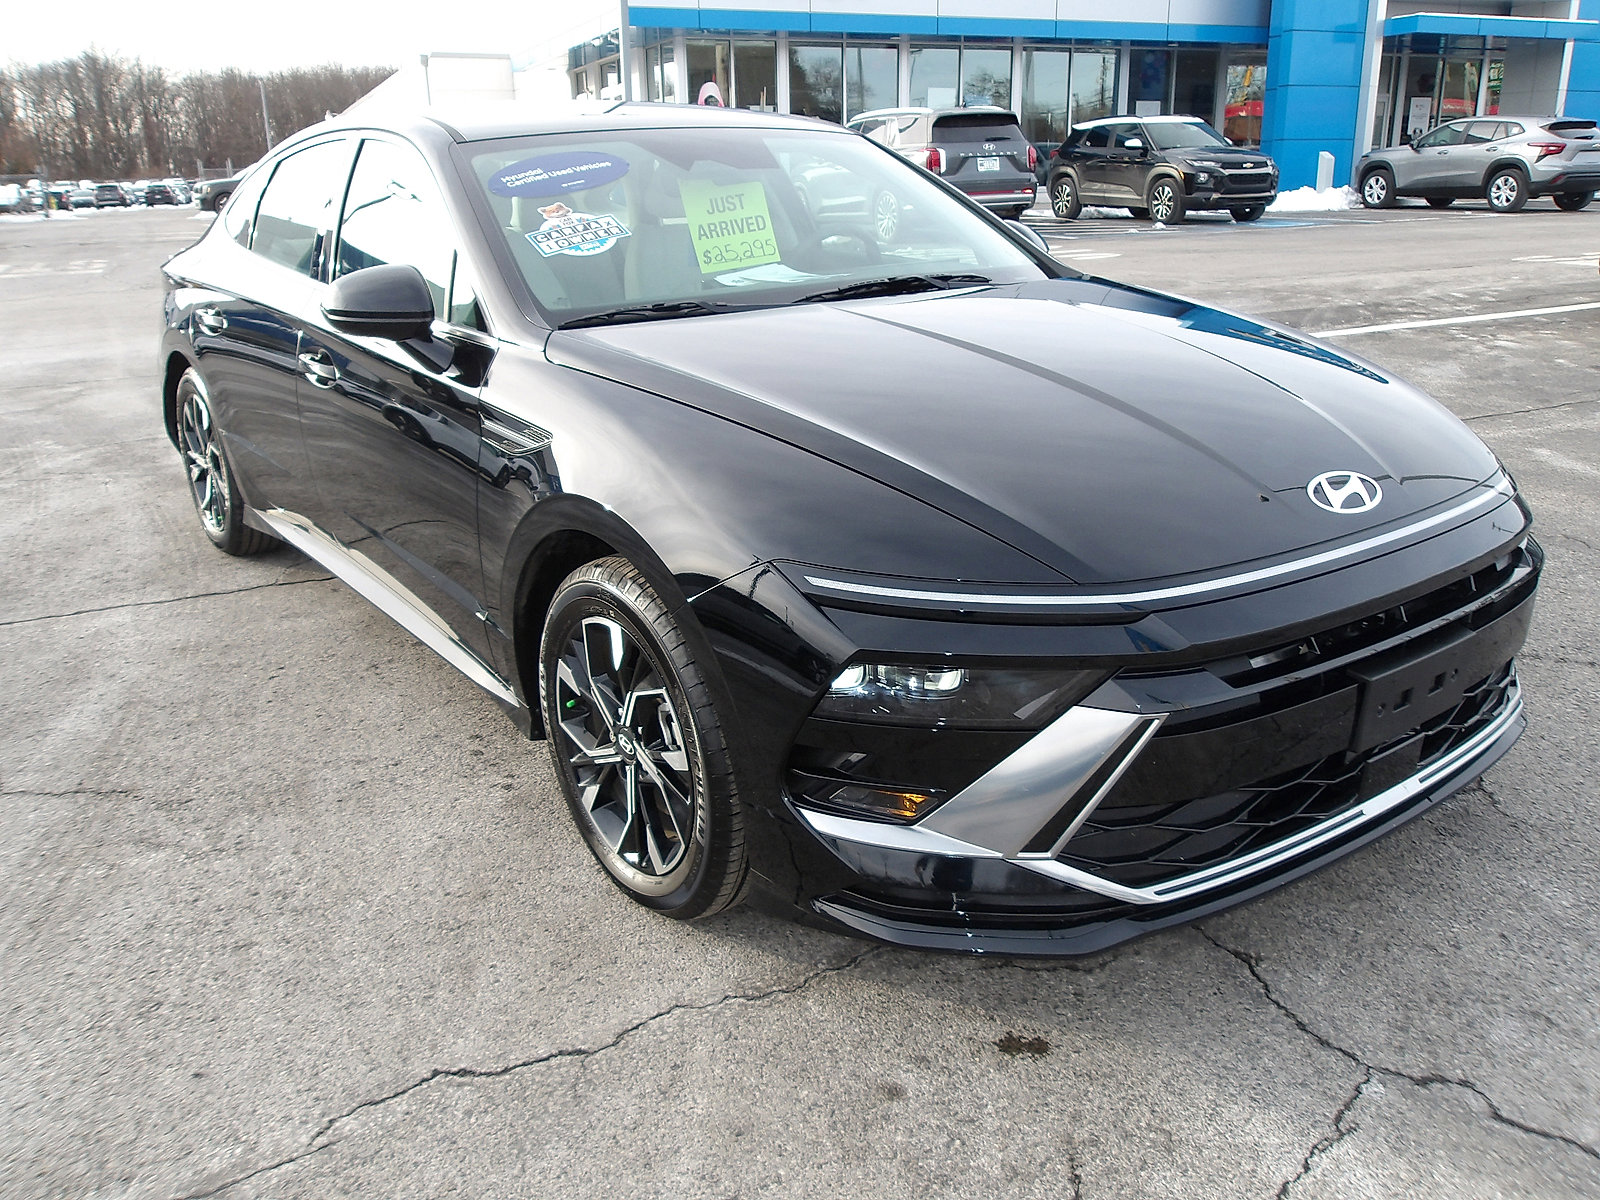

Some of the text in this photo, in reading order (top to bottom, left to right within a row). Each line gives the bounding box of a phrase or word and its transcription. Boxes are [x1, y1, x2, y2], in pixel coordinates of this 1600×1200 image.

[500, 167, 544, 183] Hyundai
[506, 172, 549, 188] Certified
[548, 167, 574, 178] Used
[572, 161, 612, 172] Vehicles
[706, 193, 745, 215] JUST
[534, 220, 613, 244] CARFAX
[556, 226, 624, 249] OWNER
[697, 215, 767, 241] ARRIVED
[703, 239, 777, 265] $25,295
